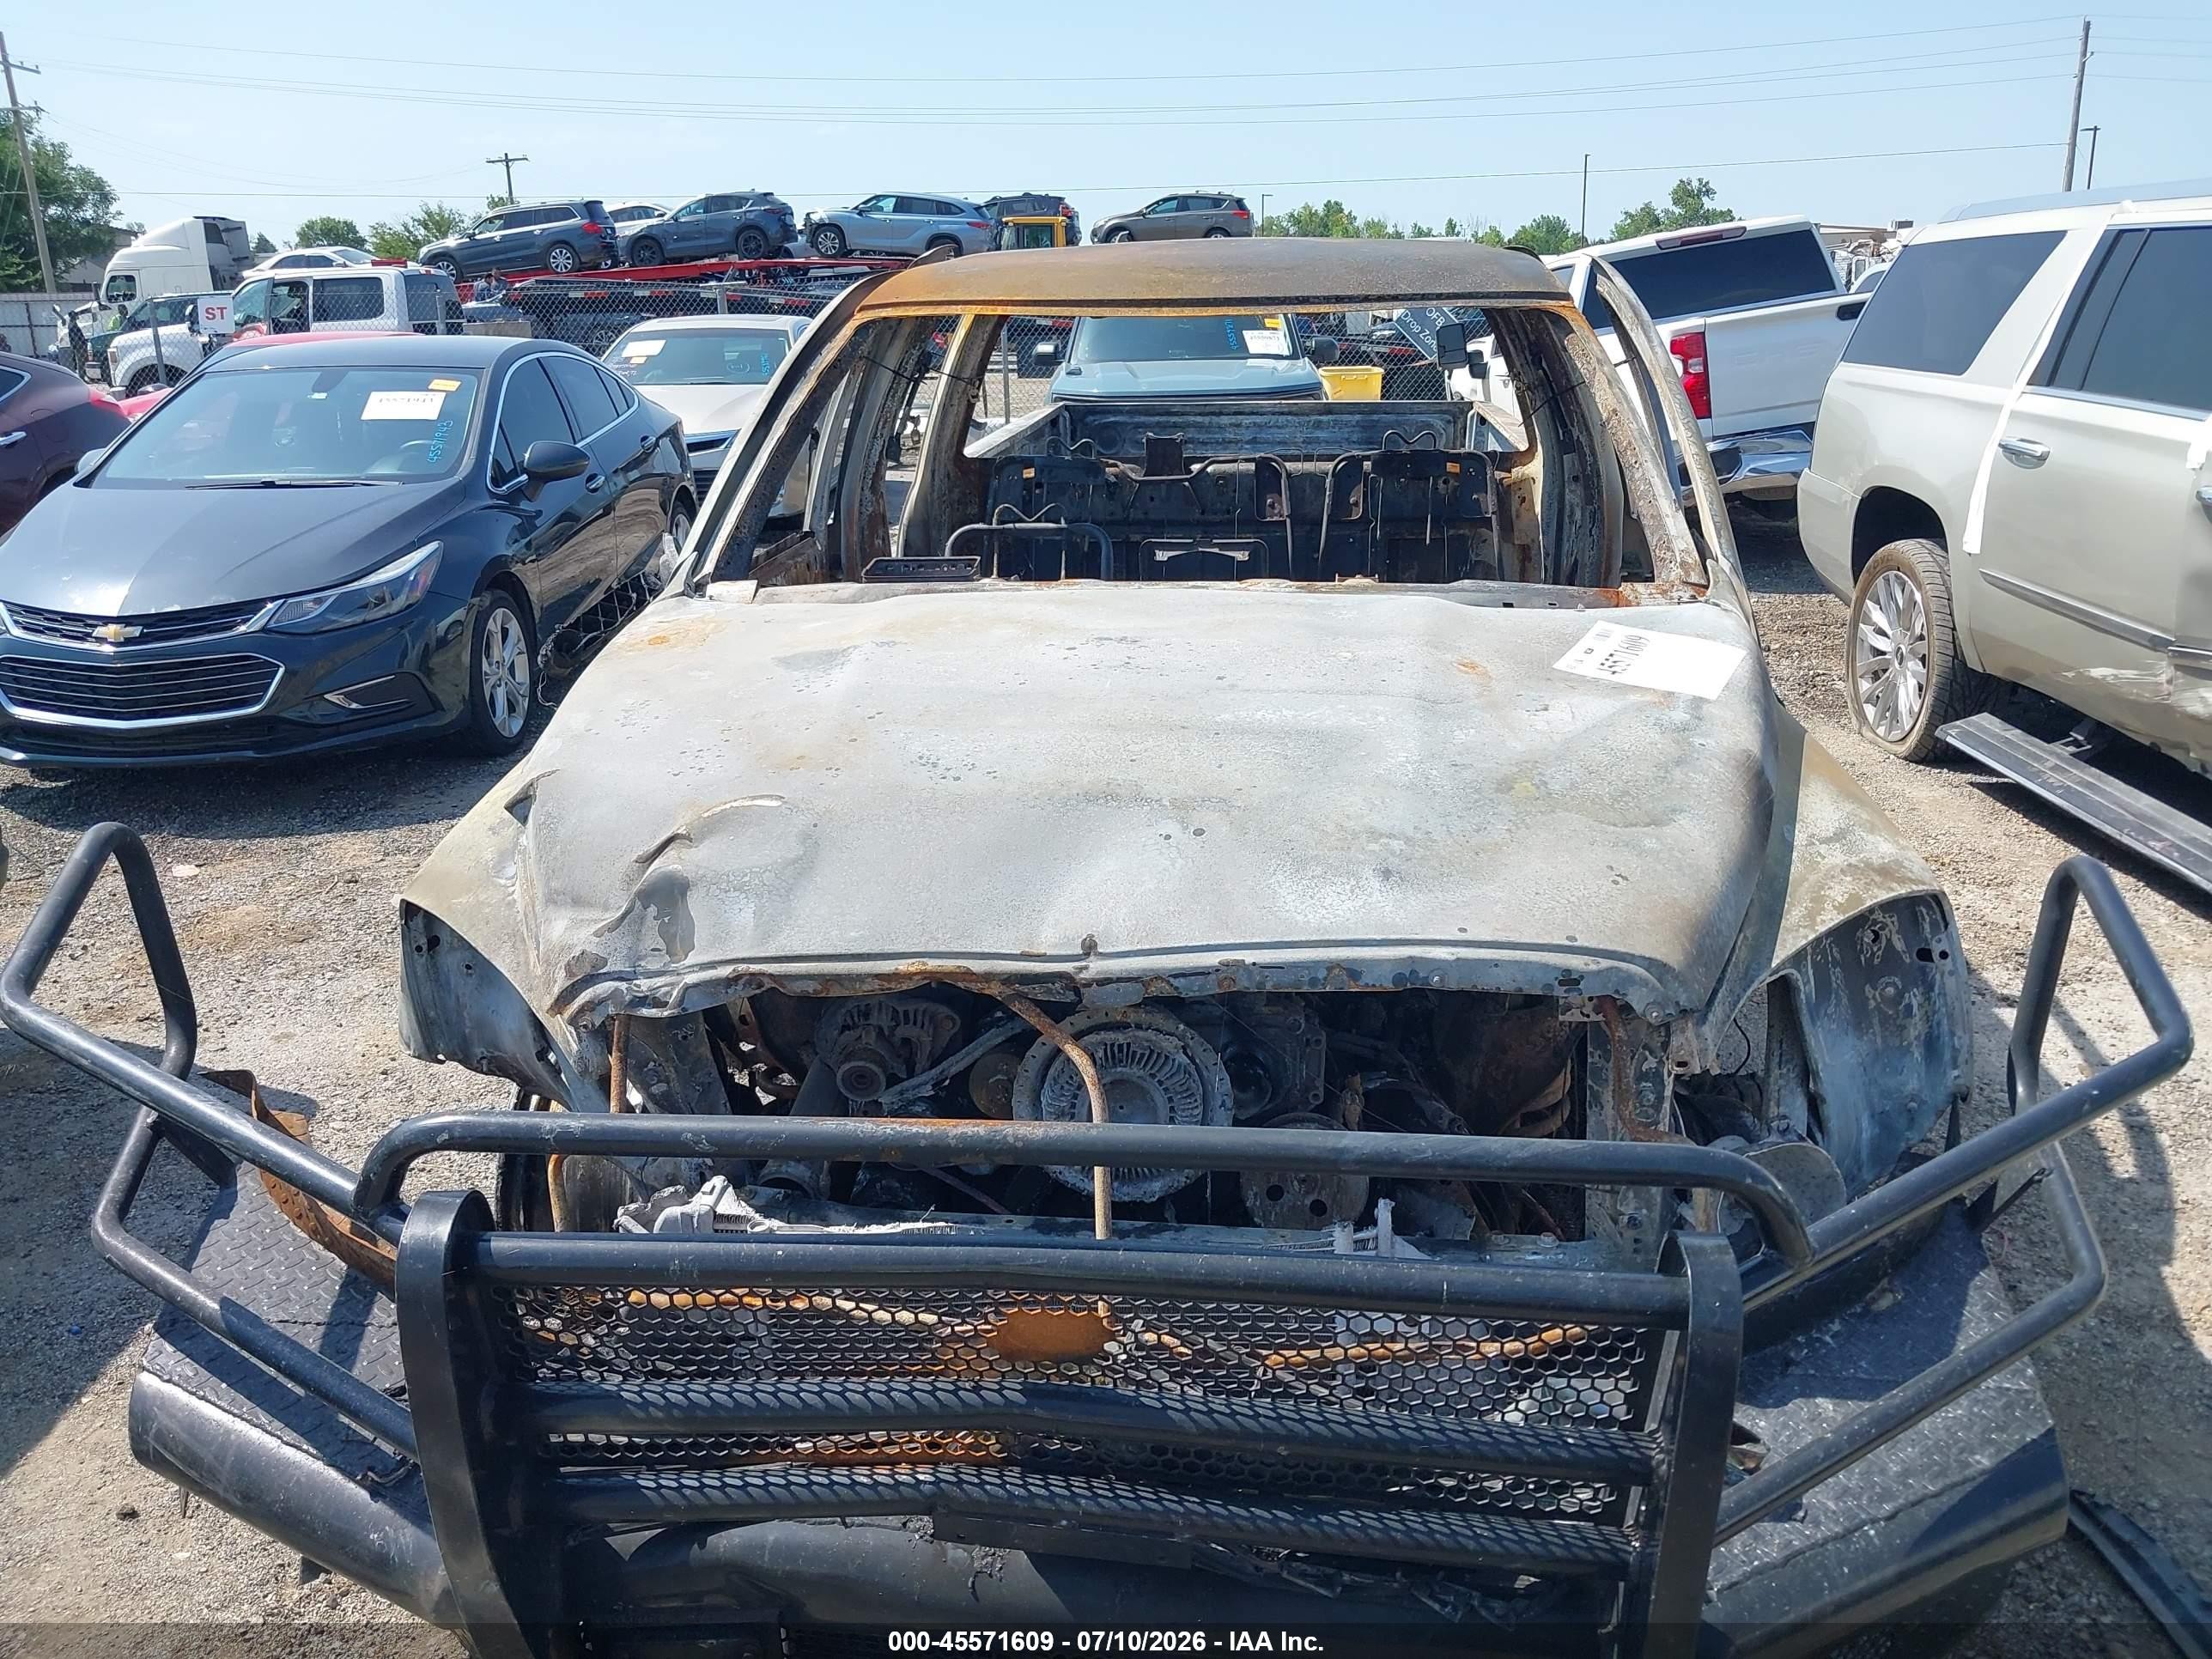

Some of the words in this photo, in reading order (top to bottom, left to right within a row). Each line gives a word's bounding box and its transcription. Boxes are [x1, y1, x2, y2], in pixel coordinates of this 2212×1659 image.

[204, 307, 228, 321] ST
[1401, 310, 1421, 333] Drop
[1425, 307, 1445, 326] OFB
[427, 420, 453, 463] 45571943
